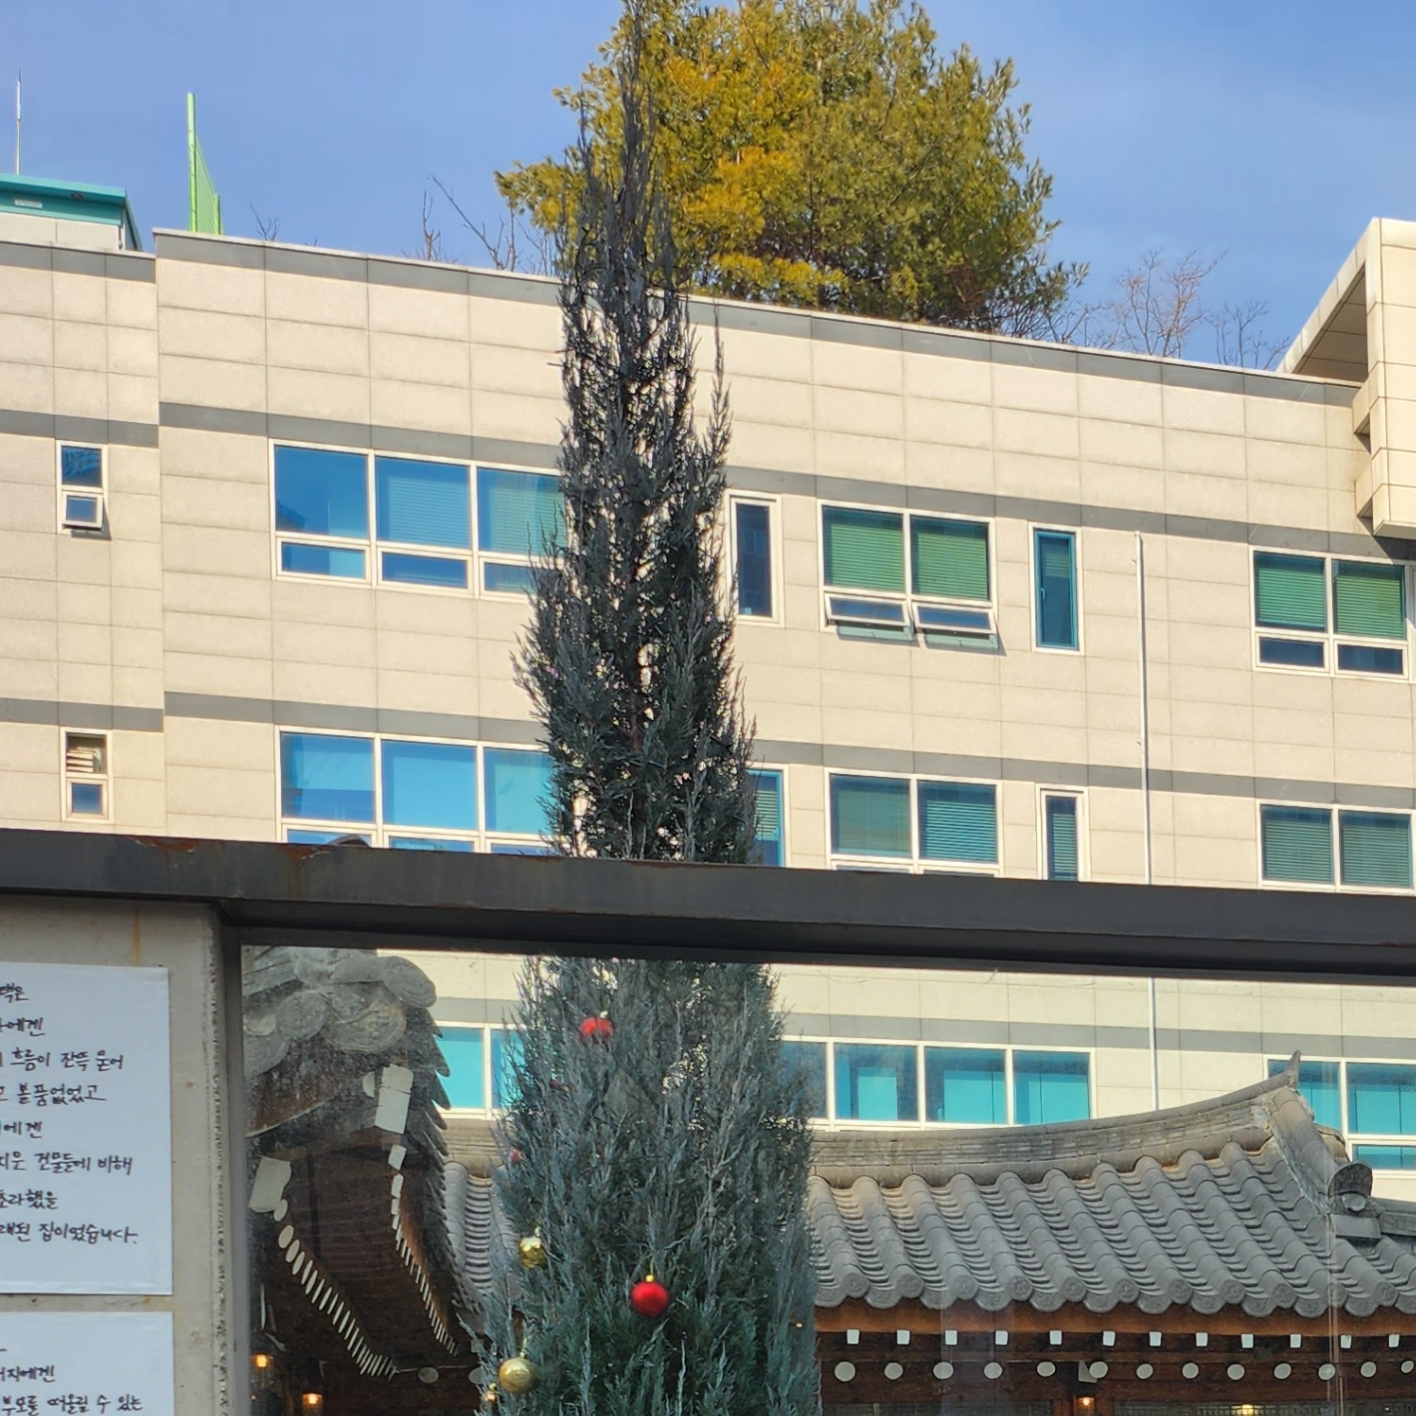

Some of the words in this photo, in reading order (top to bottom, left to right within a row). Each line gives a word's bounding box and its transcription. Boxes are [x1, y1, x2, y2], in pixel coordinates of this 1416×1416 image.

[0, 1017, 45, 1037] 에겐
[11, 1047, 50, 1071] 흐름이
[61, 1051, 89, 1071] 잔뜩
[17, 1083, 106, 1107] 볼품없었고
[0, 1121, 42, 1138] 에겐
[34, 1152, 91, 1173] 건물들에
[98, 1155, 132, 1175] 비해
[1, 1395, 39, 1416] 부모를
[97, 1395, 111, 1414] 수
[117, 1394, 142, 1411] 있는
